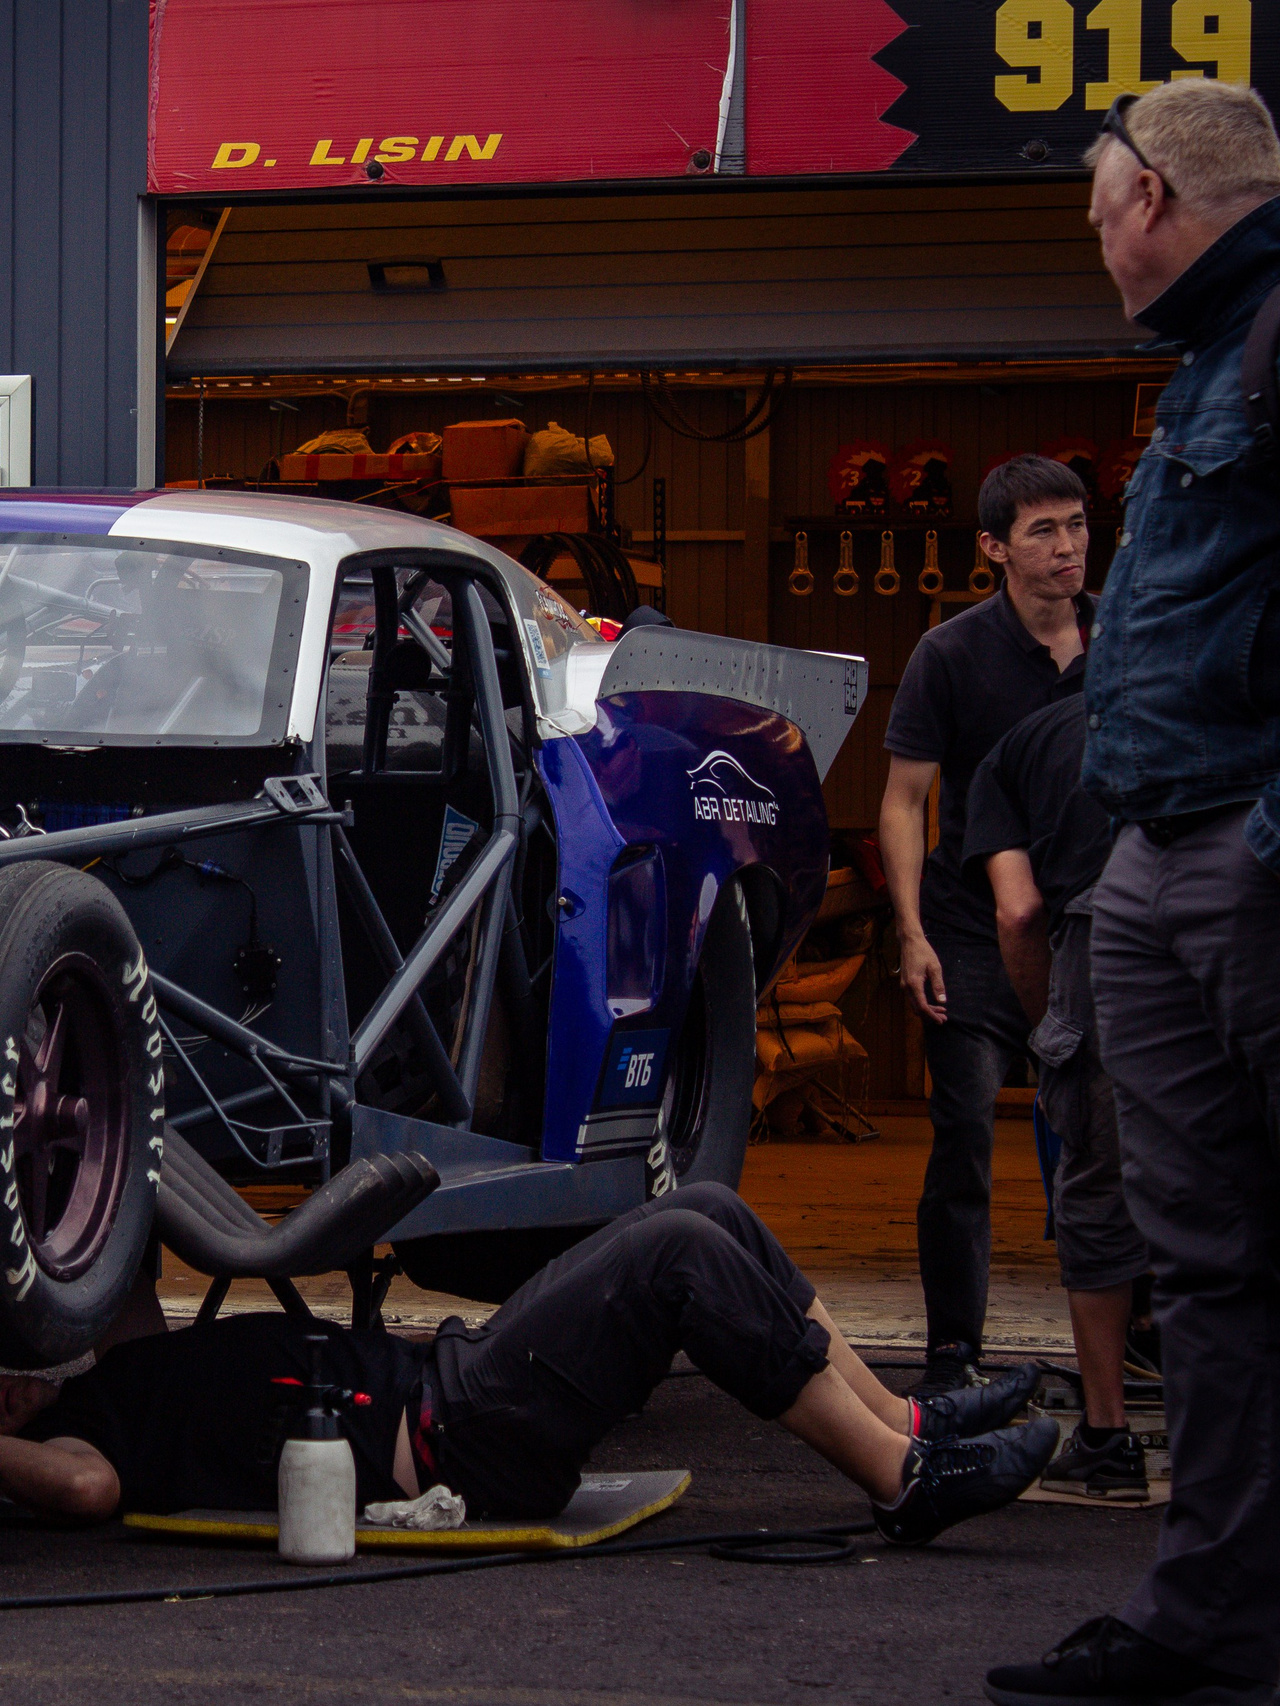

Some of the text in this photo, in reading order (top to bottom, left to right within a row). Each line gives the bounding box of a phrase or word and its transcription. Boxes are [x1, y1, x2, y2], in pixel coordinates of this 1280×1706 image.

[995, 0, 1252, 112] 919
[211, 133, 503, 168] D. LISIN
[694, 797, 721, 820] ABR
[625, 1053, 655, 1088] ВТБ
